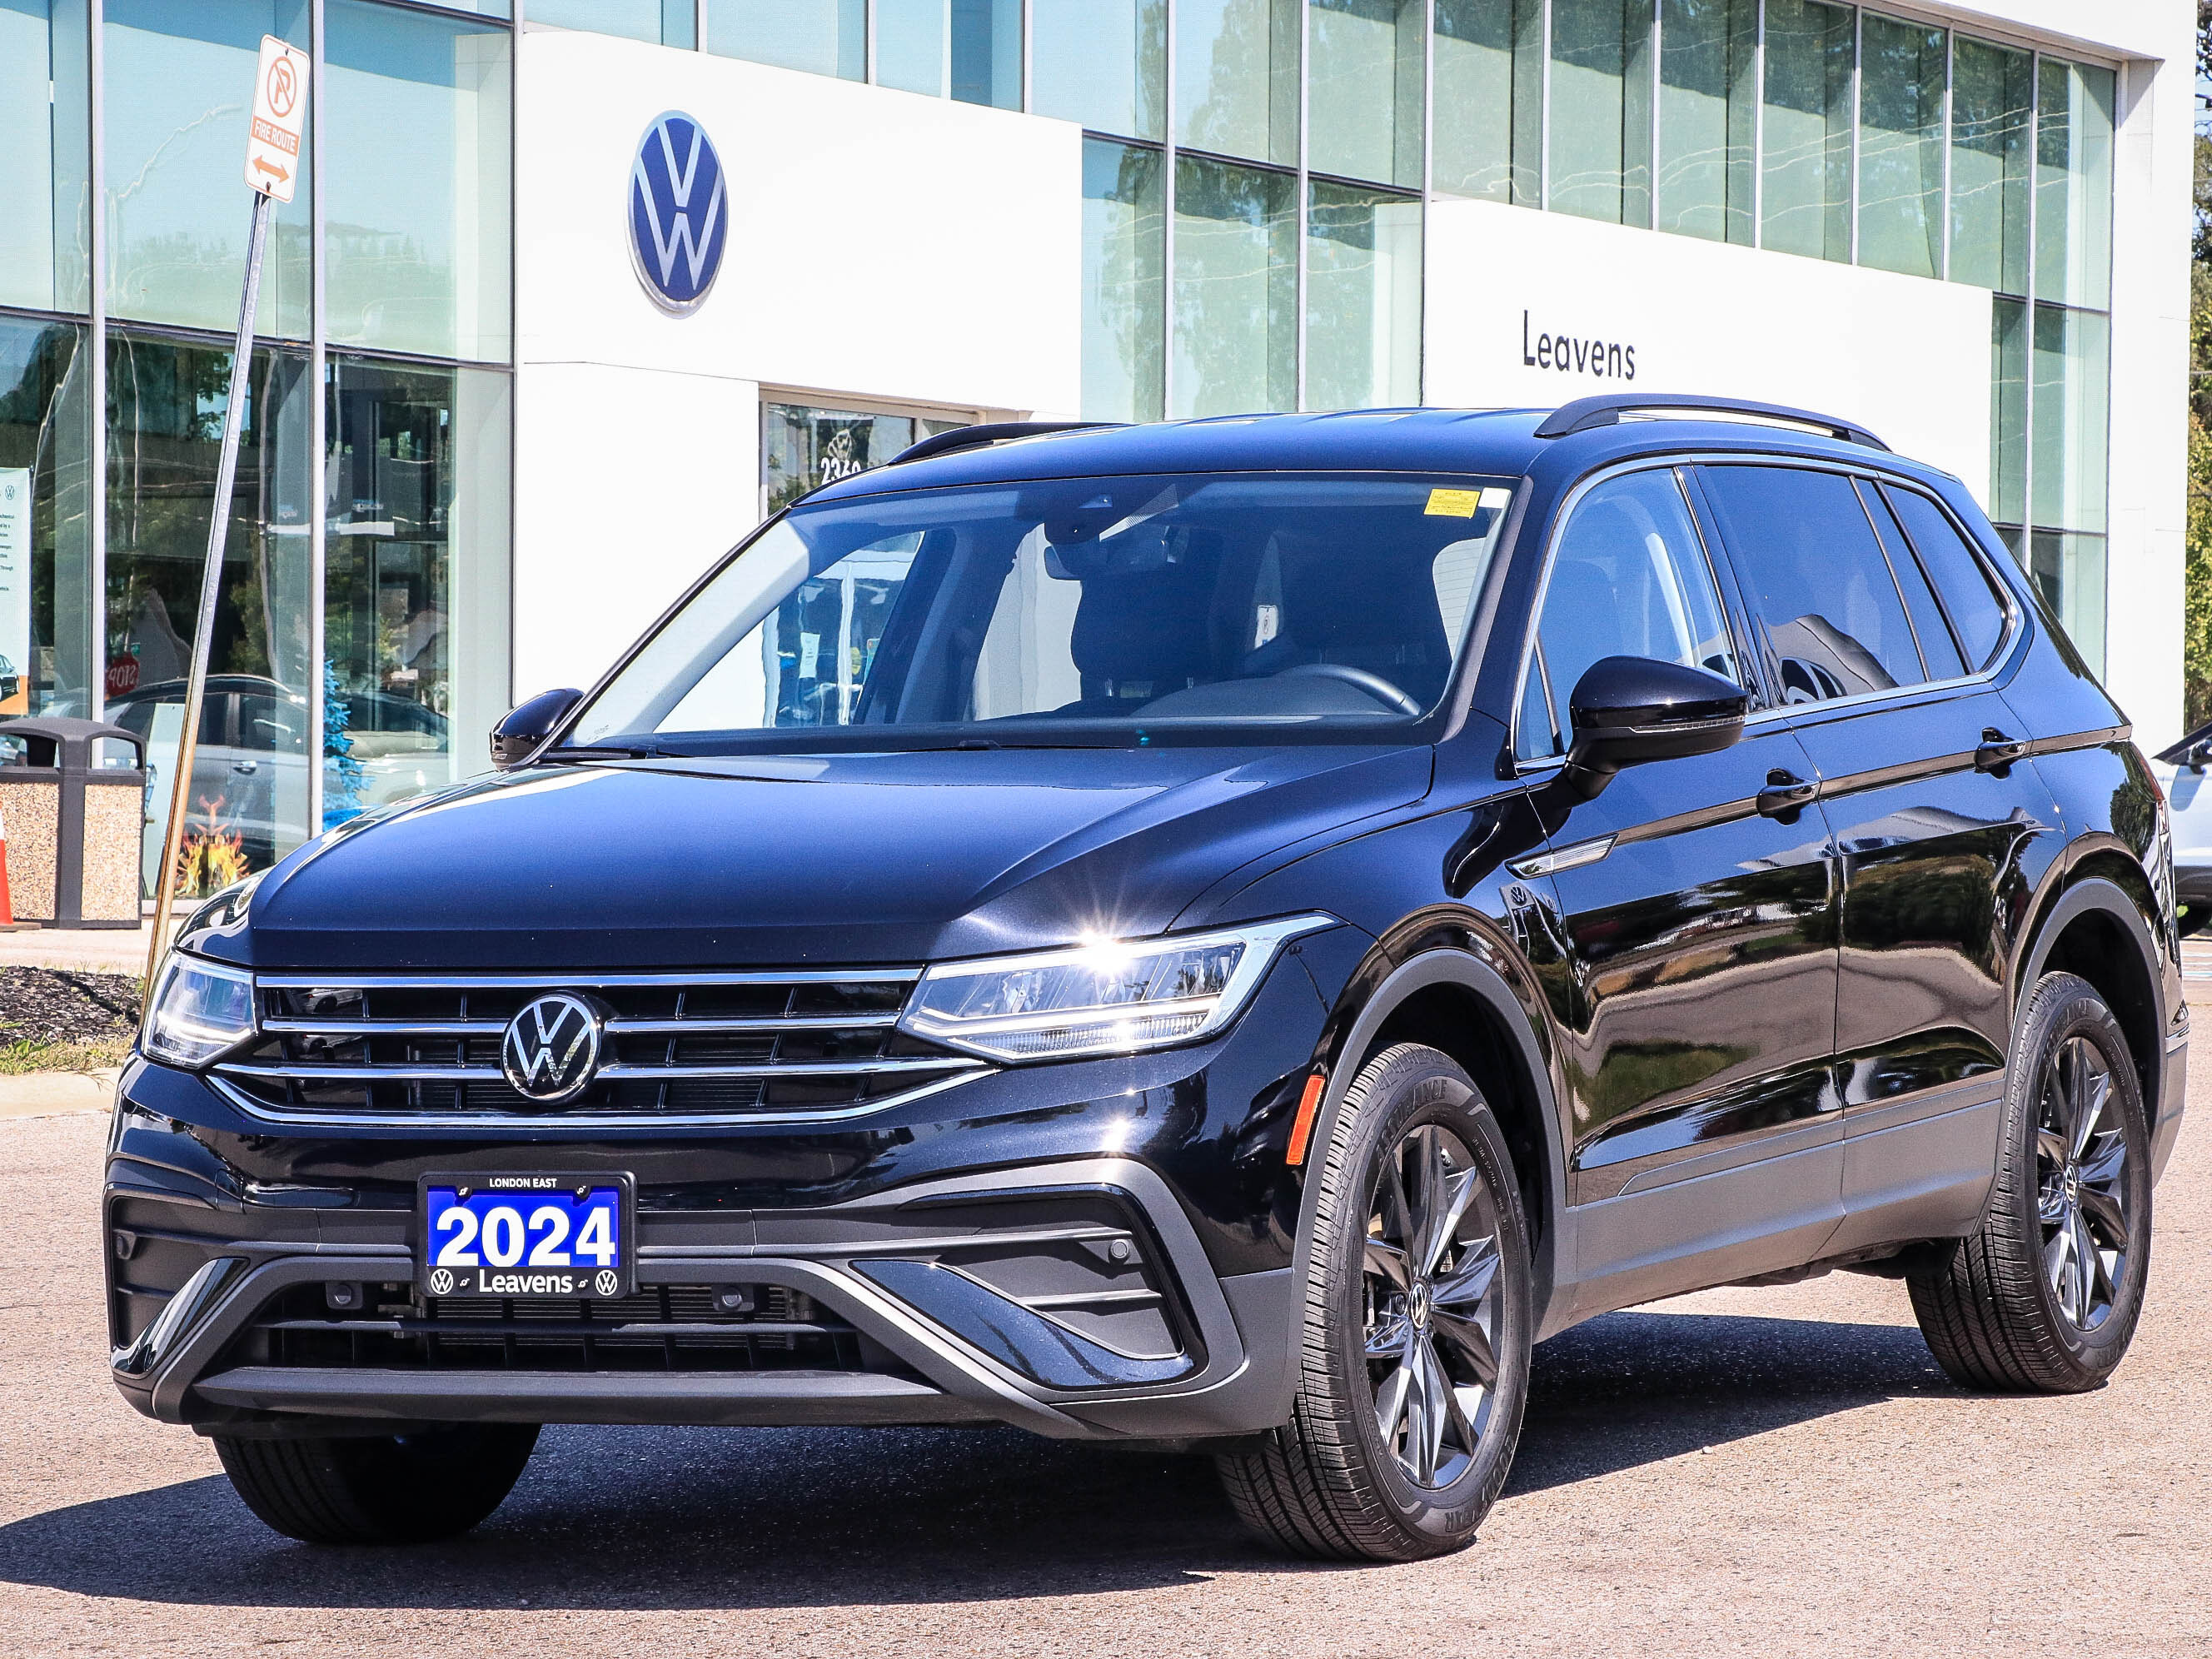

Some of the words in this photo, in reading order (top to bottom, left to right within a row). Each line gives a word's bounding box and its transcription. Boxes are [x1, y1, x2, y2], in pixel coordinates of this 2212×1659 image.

[254, 119, 272, 141] FIRE
[272, 127, 296, 152] ROUTE
[1523, 309, 1635, 381] Leavens
[503, 995, 598, 1100] VW
[489, 1178, 531, 1188] LONDON
[532, 1178, 557, 1188] EAST
[436, 1206, 615, 1268] 2024
[479, 1268, 573, 1293] Leavens
